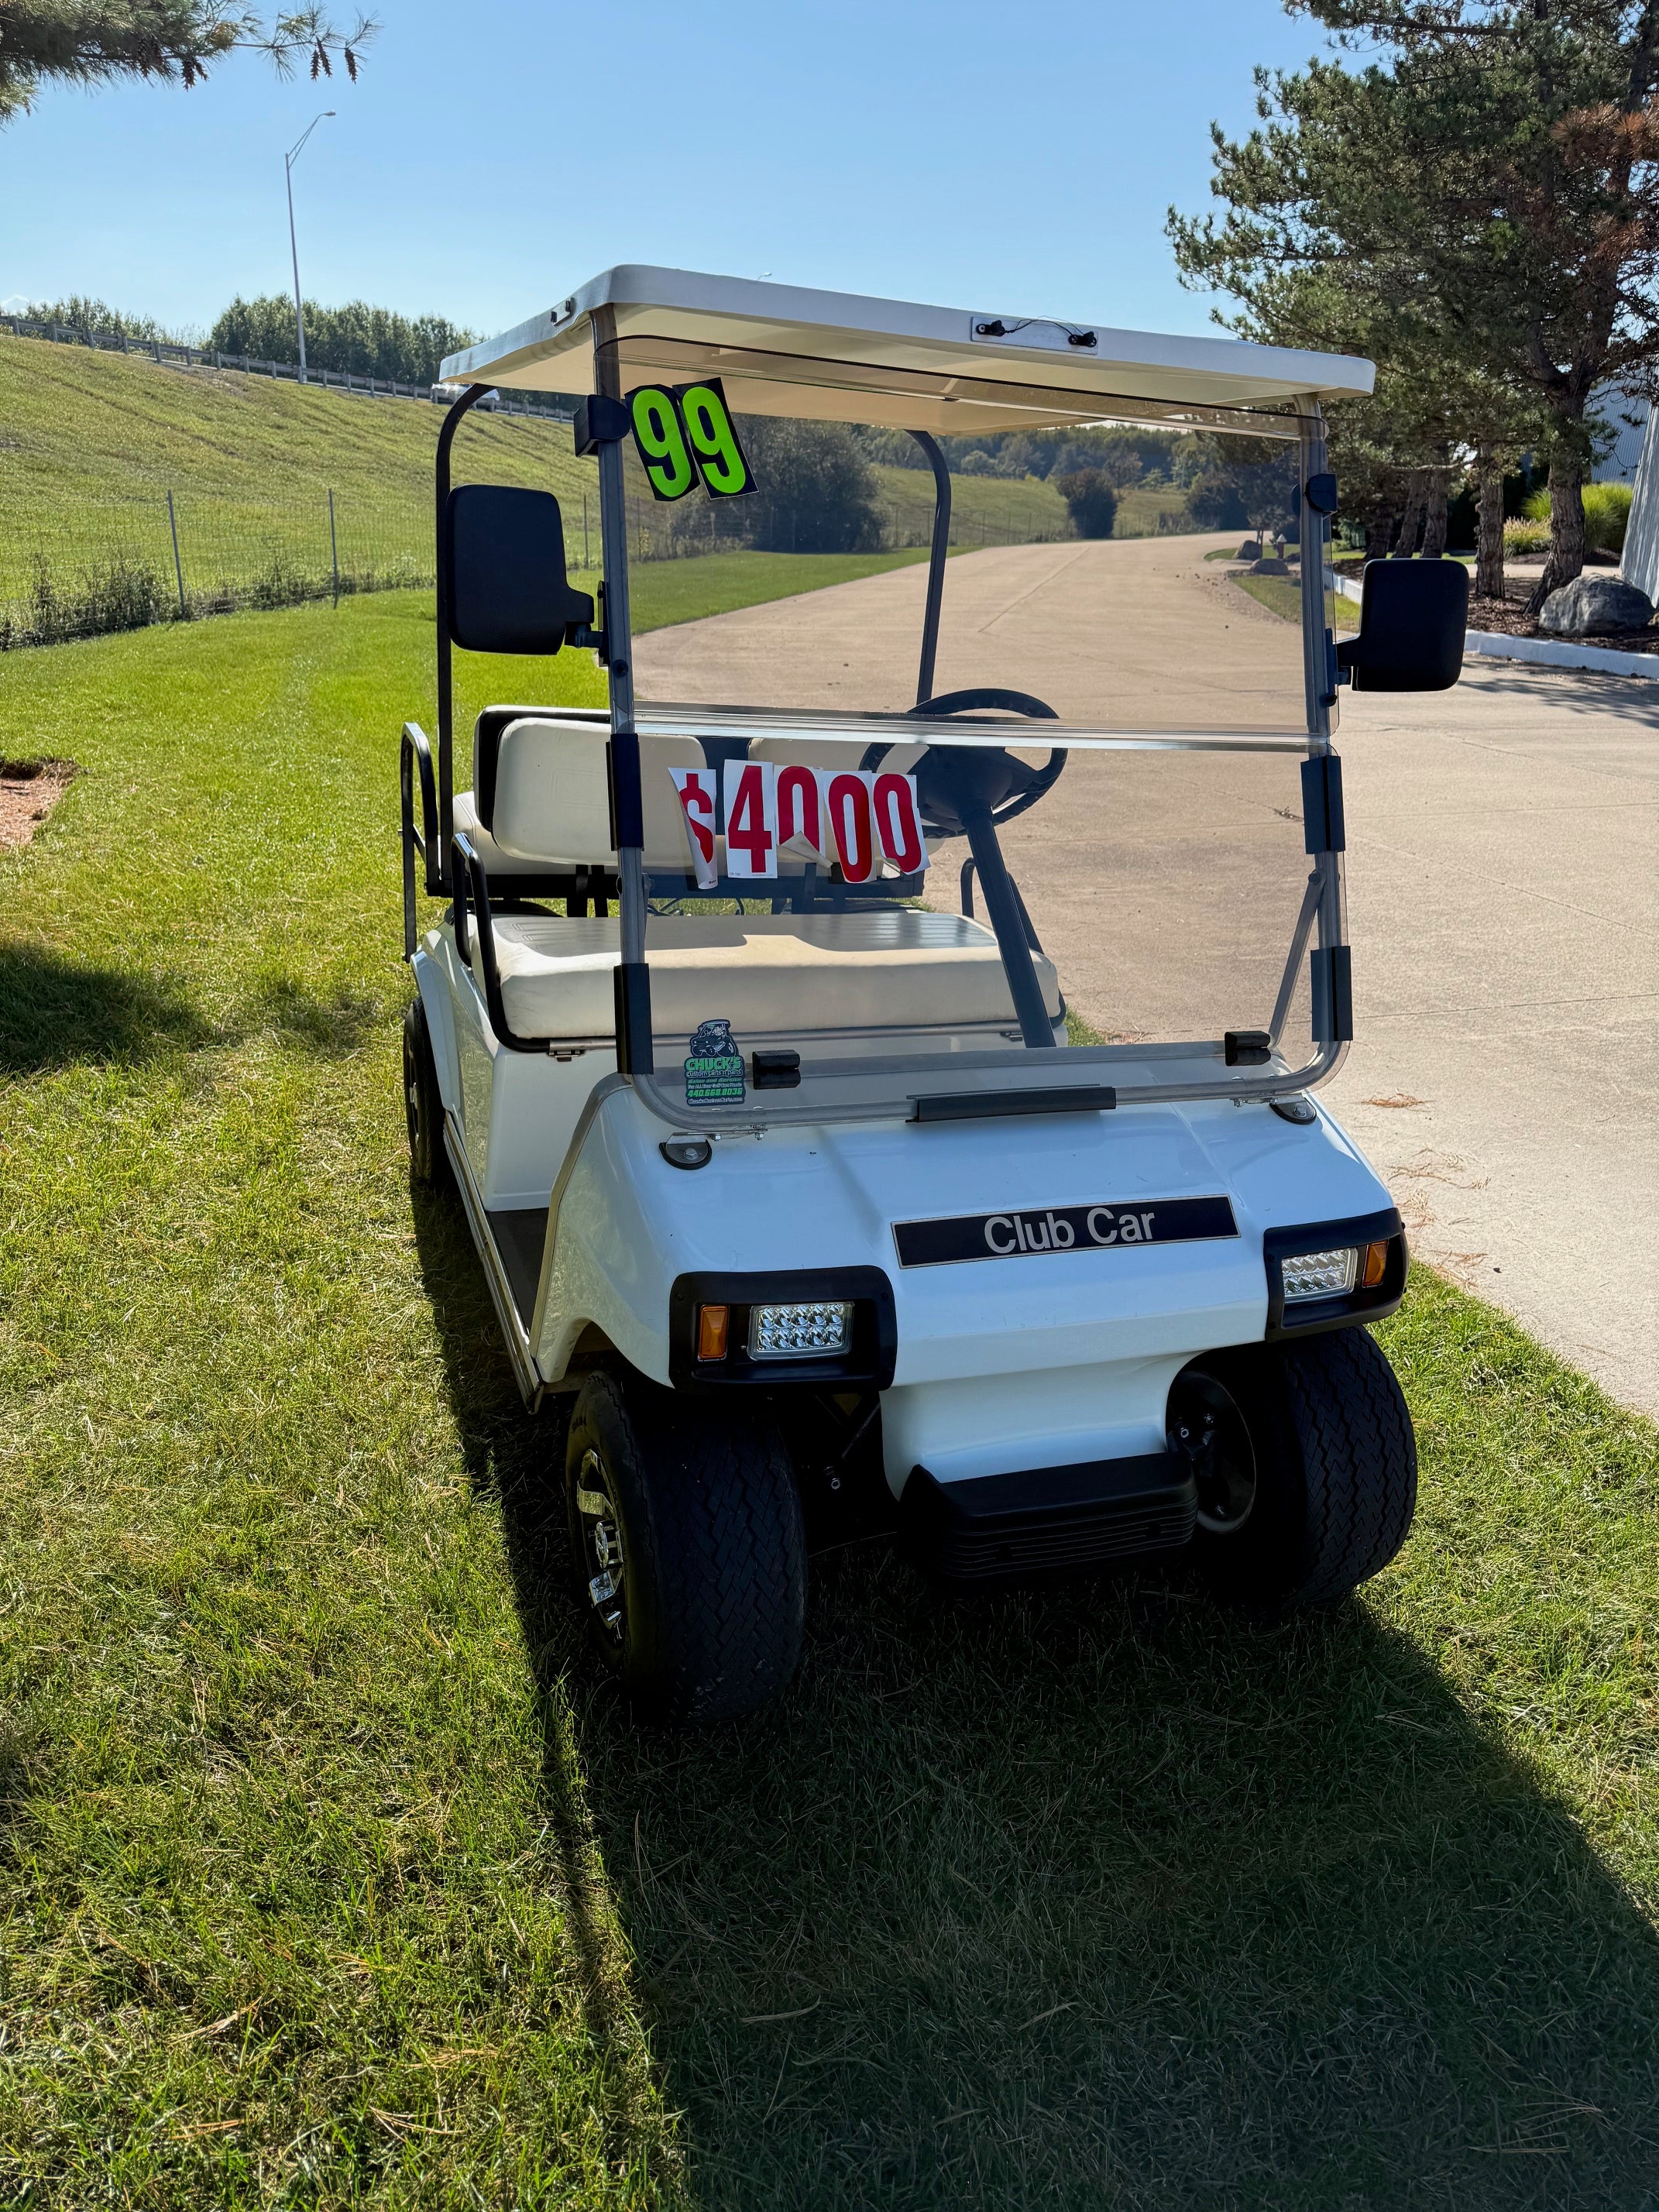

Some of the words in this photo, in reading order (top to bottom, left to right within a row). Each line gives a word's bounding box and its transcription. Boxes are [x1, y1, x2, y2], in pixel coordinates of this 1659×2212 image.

[632, 386, 747, 498] 99
[685, 1056, 741, 1071] CHUCK'S
[984, 1212, 1075, 1254] Club
[1087, 1207, 1155, 1245] Car
